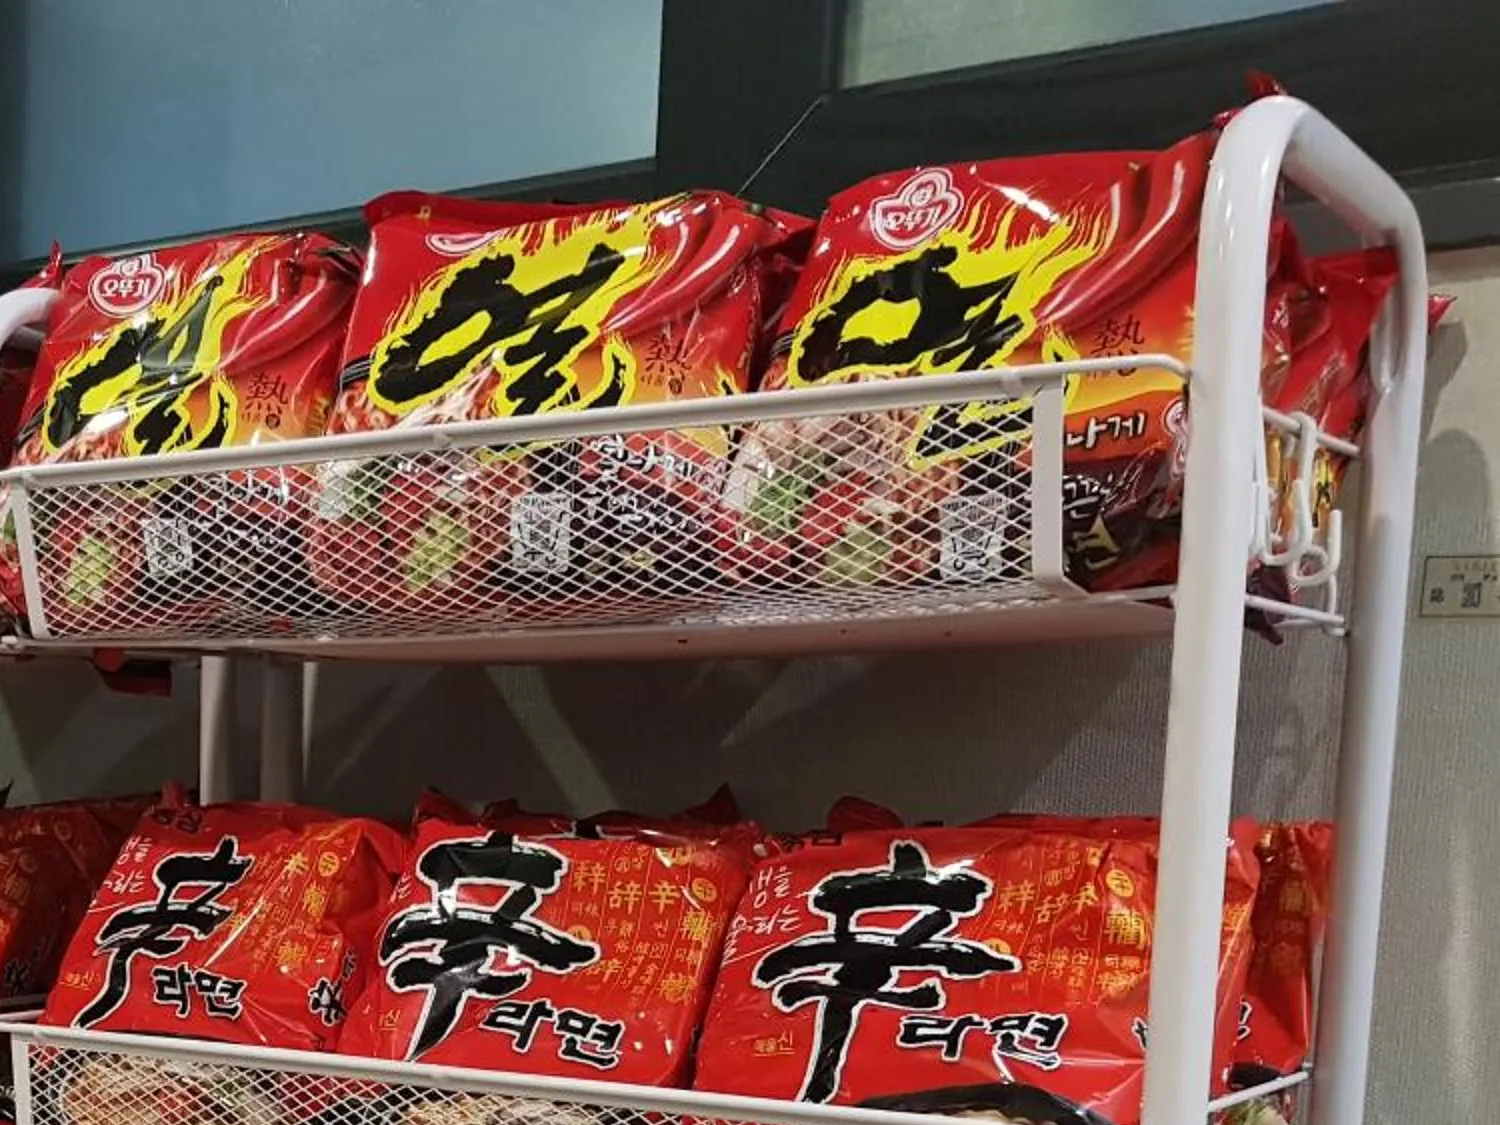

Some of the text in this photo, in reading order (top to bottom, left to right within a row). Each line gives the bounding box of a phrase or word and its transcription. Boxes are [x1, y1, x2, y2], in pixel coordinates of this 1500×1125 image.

[71, 833, 256, 1030] 辛
[151, 962, 248, 1021] 라면
[378, 829, 601, 1063] 辛
[752, 839, 1021, 1104] 辛
[482, 998, 626, 1071] 라면
[894, 1009, 1068, 1070] 라면
